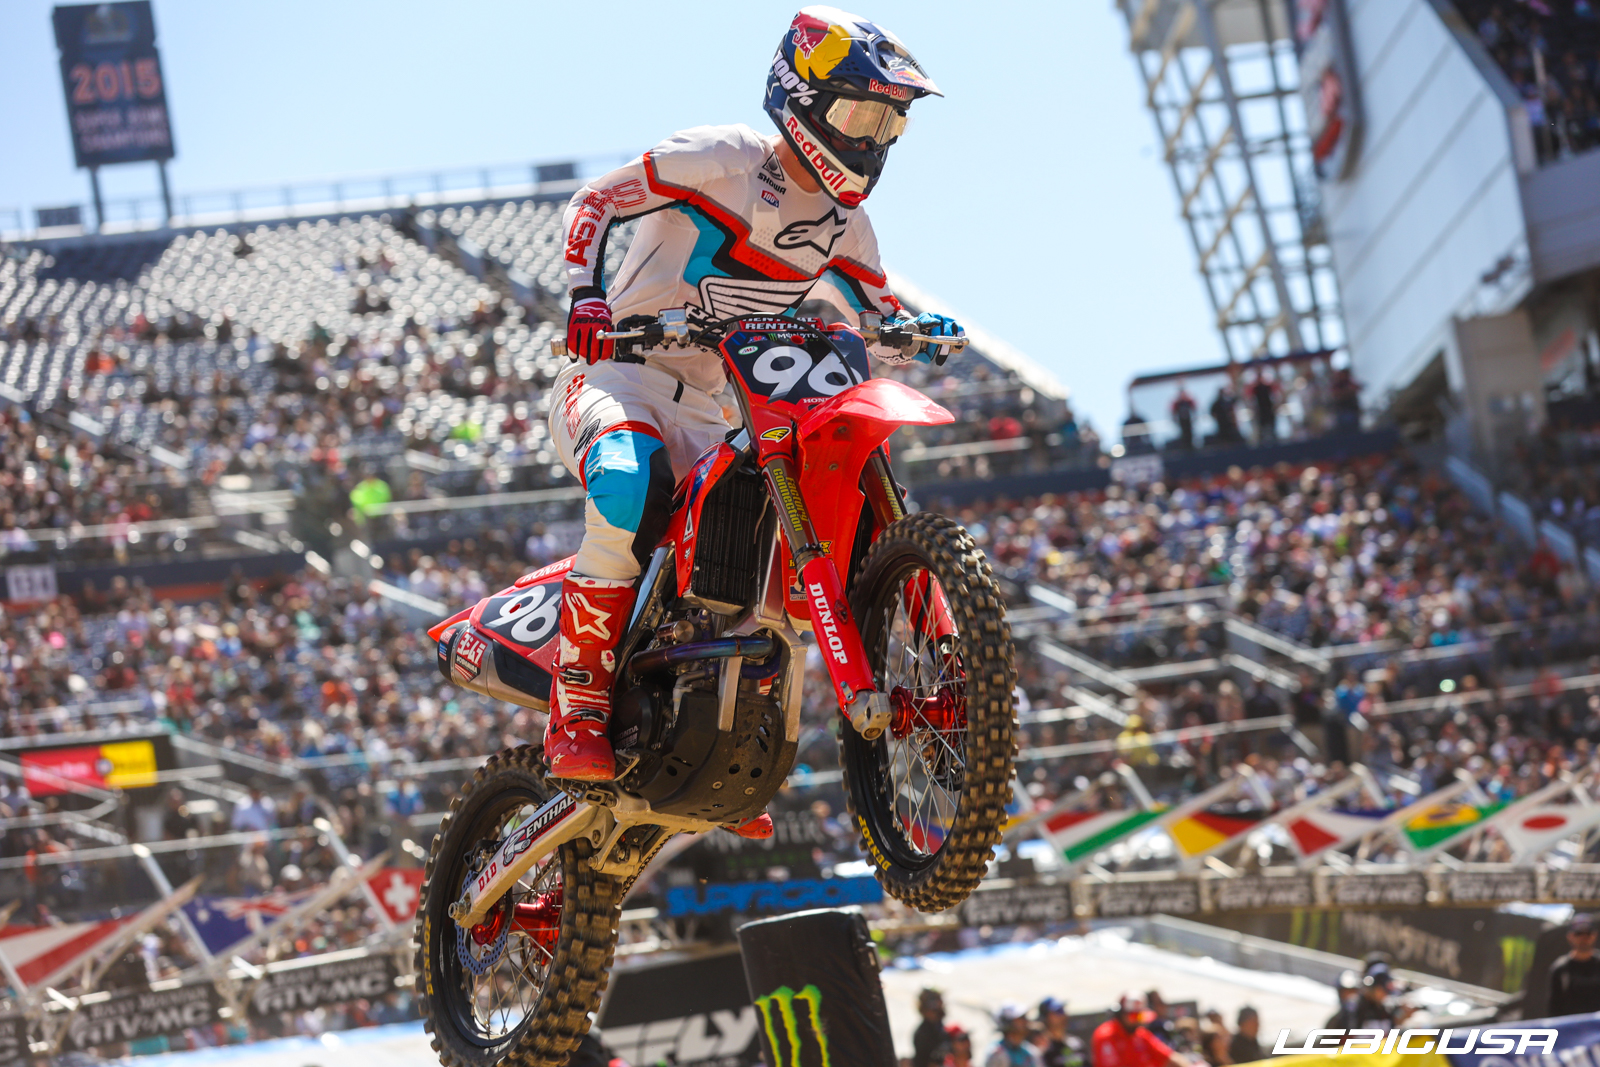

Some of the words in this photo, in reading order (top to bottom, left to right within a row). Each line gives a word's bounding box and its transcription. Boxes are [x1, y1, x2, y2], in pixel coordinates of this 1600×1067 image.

[70, 57, 162, 104] 2015
[772, 49, 819, 107] 100%
[869, 78, 891, 95] Red
[890, 84, 907, 100] Bull
[786, 116, 818, 157] Red
[757, 171, 787, 195] SHOWA
[752, 346, 864, 404] 96
[520, 559, 572, 584] HONDA
[485, 585, 562, 643] 96
[809, 583, 848, 665] DUNLOP
[858, 814, 892, 871] DUNLOP
[478, 862, 497, 893] DID
